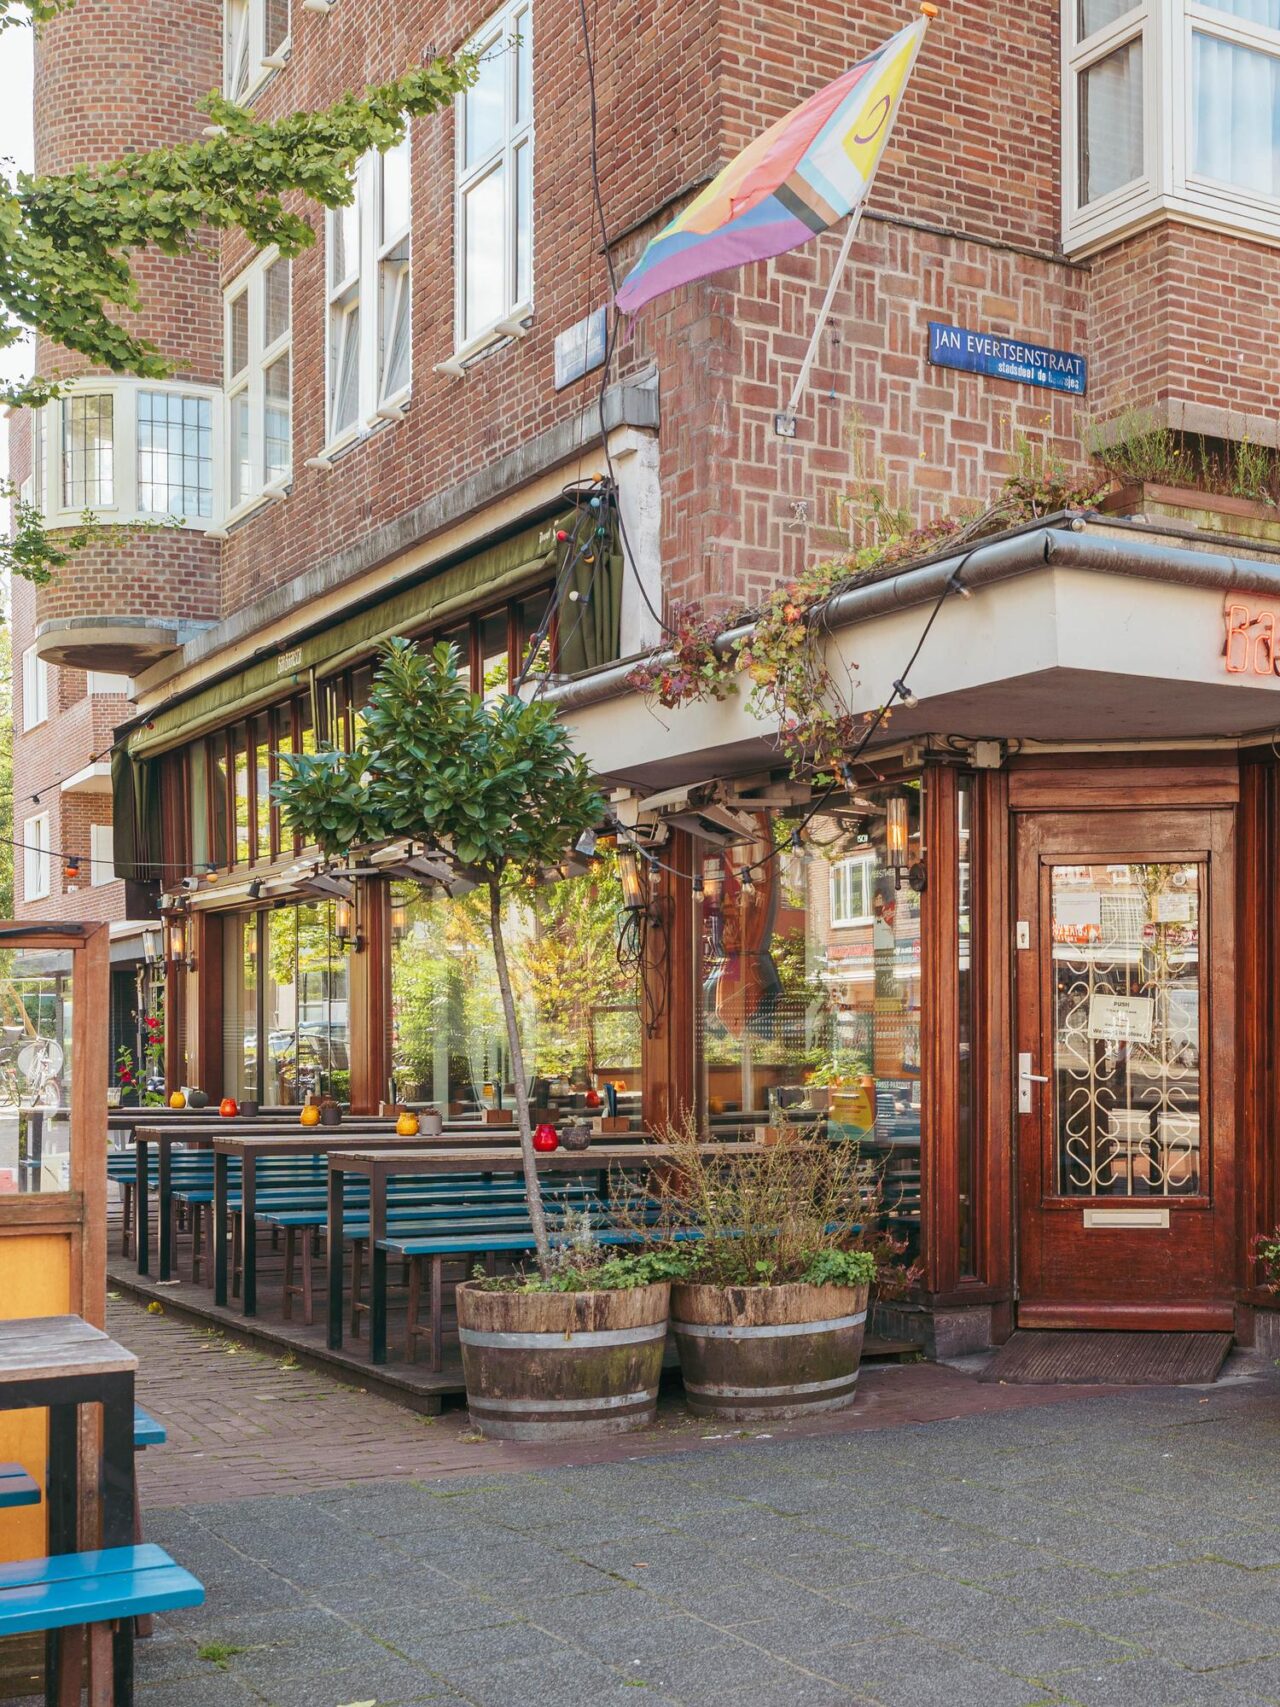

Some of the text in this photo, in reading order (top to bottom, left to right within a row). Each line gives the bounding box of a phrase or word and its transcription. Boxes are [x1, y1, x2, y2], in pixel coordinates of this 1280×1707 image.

[935, 329, 1081, 375] JAN EVERTSENSTRAAT
[998, 362, 1034, 379] stadsdeel
